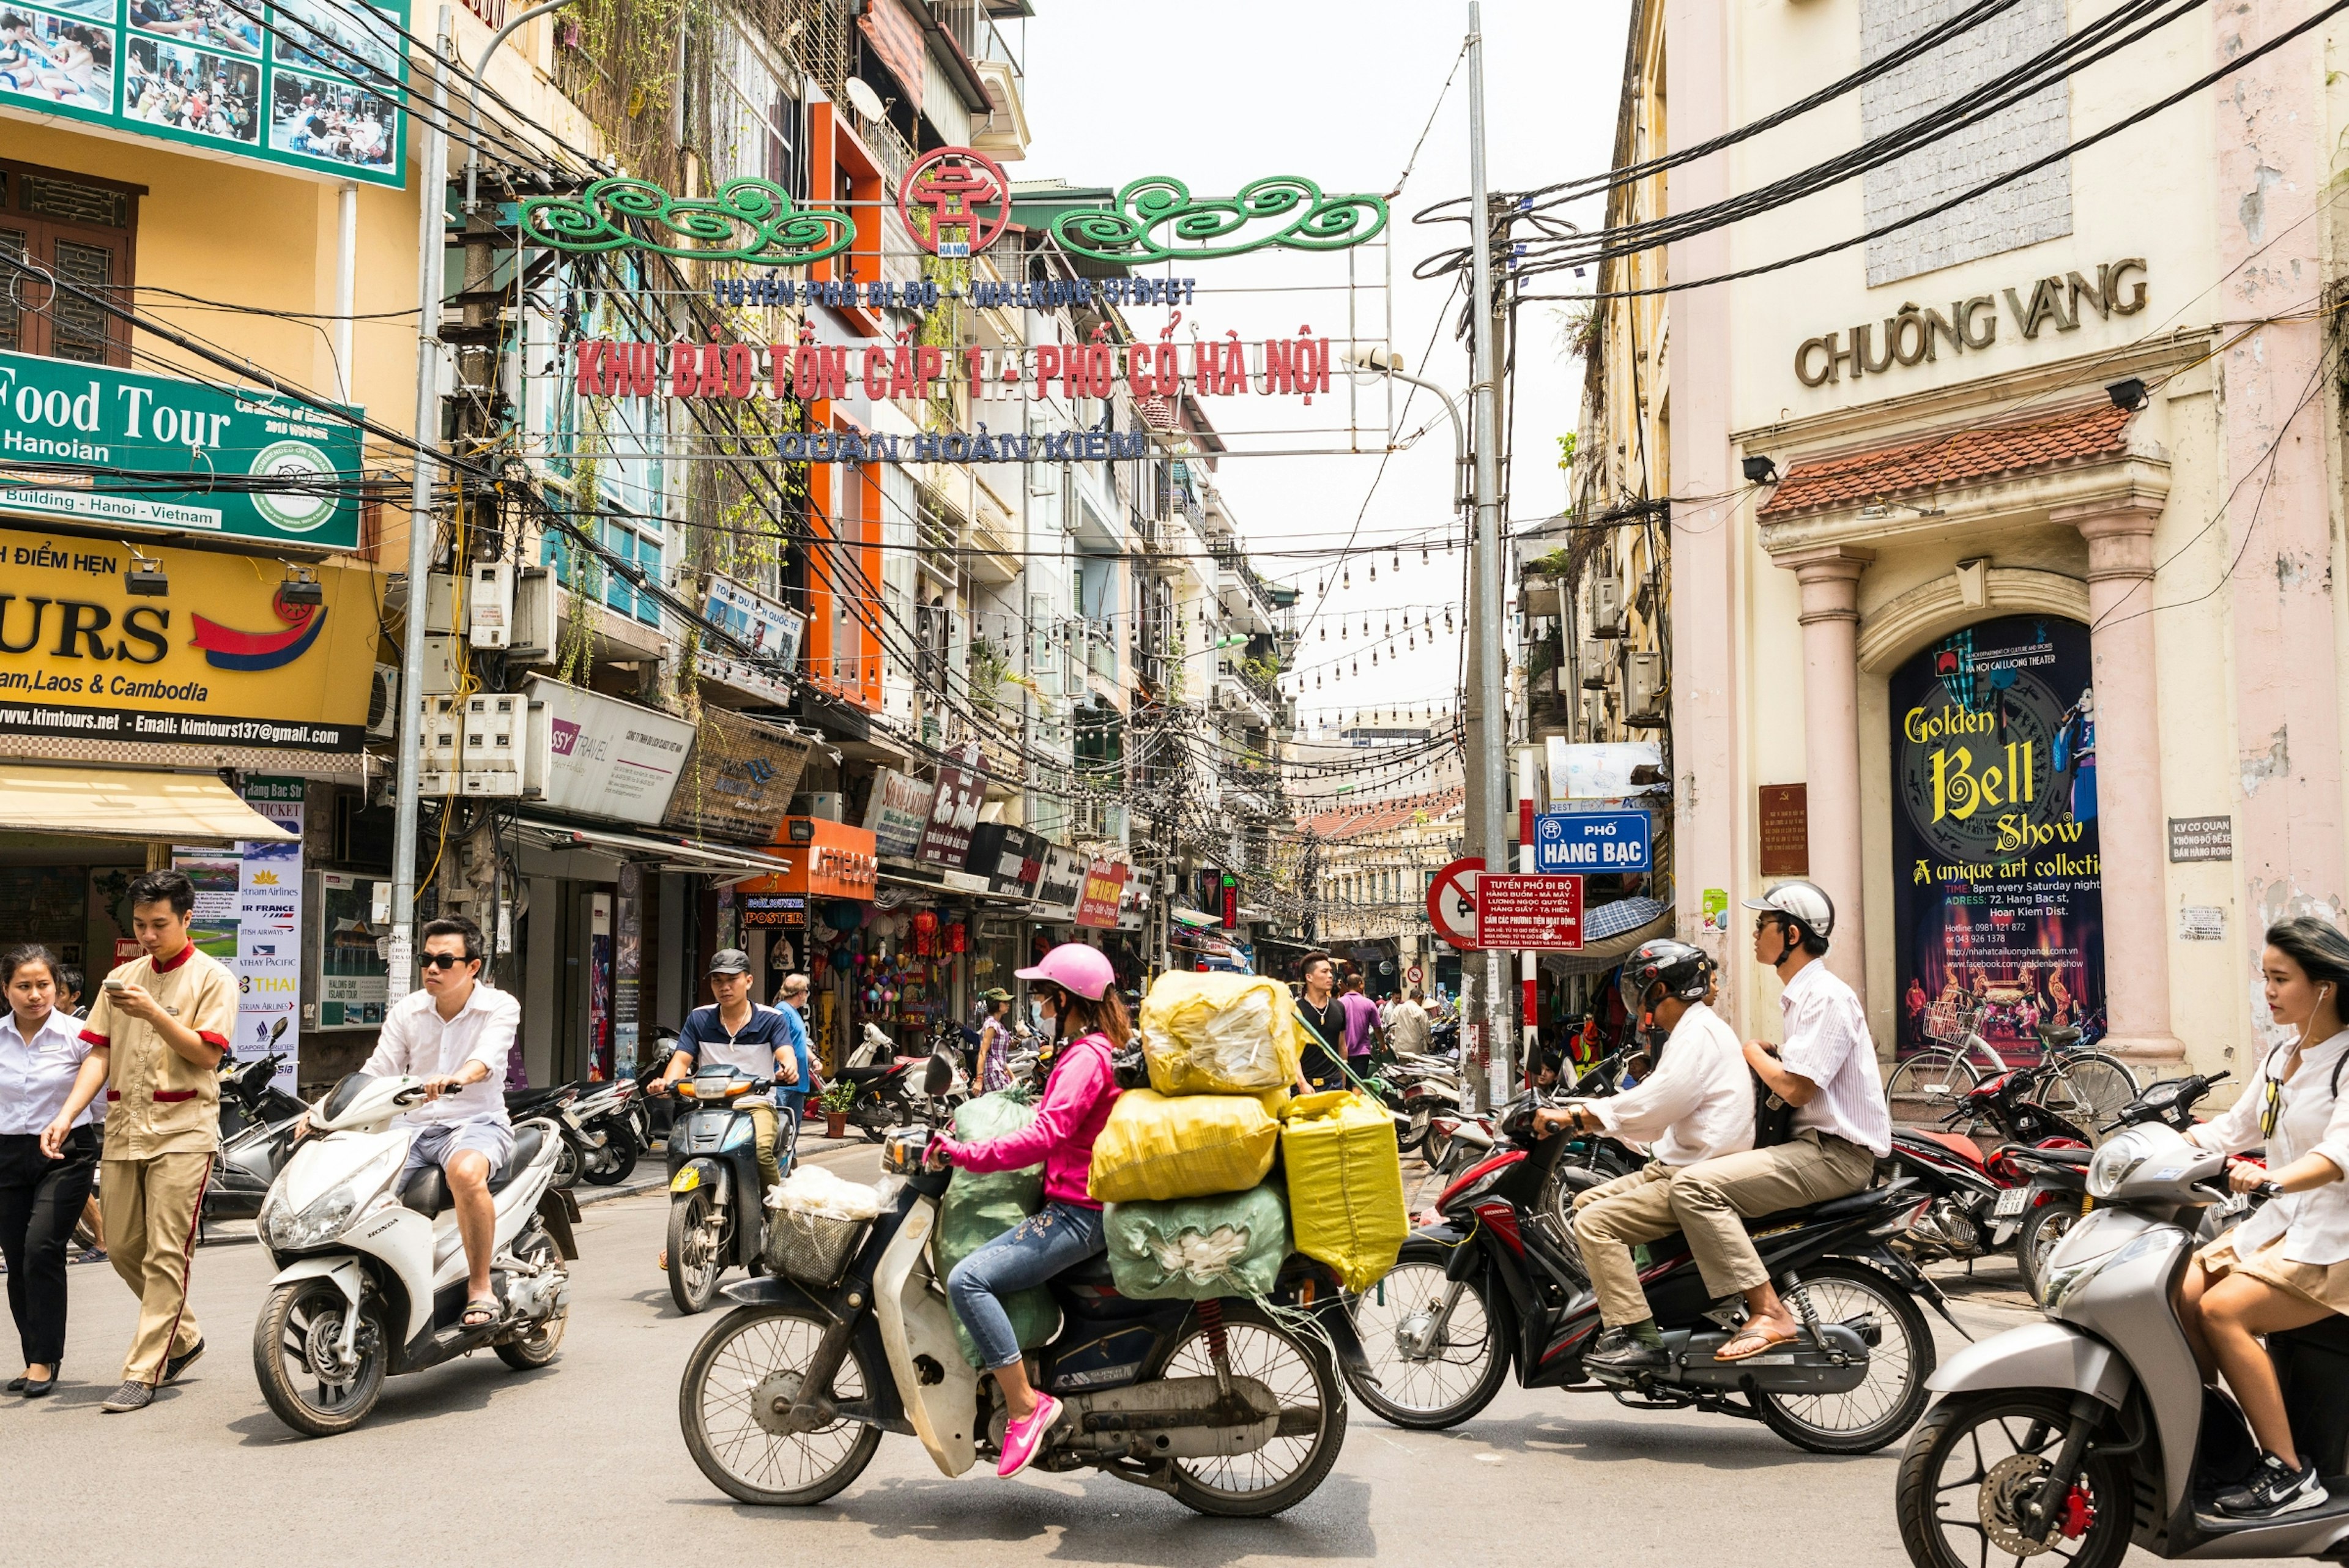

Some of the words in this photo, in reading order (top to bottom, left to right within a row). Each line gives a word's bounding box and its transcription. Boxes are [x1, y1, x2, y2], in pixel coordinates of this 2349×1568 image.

[940, 243, 951, 255] HÀ
[953, 244, 968, 258] NỘI
[713, 267, 795, 307] TUYẾN
[869, 280, 894, 308] ĐI
[973, 277, 1092, 307] WALKING
[1105, 277, 1195, 307] STREET
[1794, 300, 1997, 388] CHUÔNG
[2002, 257, 2148, 339] VÀNG
[577, 339, 656, 399] KHU
[673, 324, 752, 399] BẢO
[769, 320, 847, 400] TỒN
[863, 322, 942, 401] CẤP
[965, 350, 981, 399] 1
[1039, 321, 1113, 400] PHỐ
[1129, 310, 1180, 398] CỔ
[1195, 329, 1248, 396] HÀ
[1266, 324, 1330, 406] NỘI
[118, 385, 231, 448] Tour
[265, 420, 288, 434] 2015
[4, 429, 109, 463] Hanoian
[778, 425, 897, 472] QUẬN
[916, 422, 1030, 463] HOÀN
[1042, 415, 1145, 461] KIẾM
[6, 489, 75, 510] Building
[90, 497, 136, 515] Hanoi
[151, 506, 213, 524] Vietnam
[14, 540, 68, 570] ĐIỂM
[73, 554, 117, 576] HẸN
[738, 595, 749, 608] DU
[790, 620, 801, 632] TẾ
[1980, 648, 2003, 657] DEPARTMENT
[2010, 645, 2028, 655] CULTURE
[2036, 642, 2054, 651] SPORTS
[1965, 664, 1975, 674] HA
[1976, 662, 1990, 672] NOI
[1991, 661, 2002, 671] CAI
[2003, 657, 2028, 670] LUONG
[2028, 654, 2055, 667] THEATER
[89, 678, 105, 694] &
[109, 675, 209, 702] Cambodia
[1904, 704, 1995, 743] Golden
[135, 719, 178, 735] Email:
[180, 719, 340, 745] kimtours137@gmail.com
[573, 734, 609, 762] TRAVEL
[247, 782, 269, 798] Hang
[271, 782, 288, 798] Bac
[289, 784, 303, 798] Str
[1928, 741, 2035, 825] Bell
[258, 803, 301, 817] TICKET
[1550, 803, 1573, 811] REST
[1584, 821, 1618, 836] PHỐ
[1995, 811, 2083, 852] Show
[2188, 822, 2201, 832] CƠ
[2202, 821, 2230, 832] QUAN
[2173, 834, 2200, 845] KHÔNG
[2222, 834, 2232, 844] XE
[1545, 839, 1597, 863] HÀNG
[1603, 841, 1642, 866] BẠC
[2173, 846, 2189, 858] BÁN
[2189, 846, 2210, 857] HÀNG
[2210, 846, 2232, 856] RONG
[1913, 858, 1931, 885] A
[1936, 860, 1994, 885] unique
[2000, 856, 2028, 877] art
[268, 887, 299, 896] Airlines
[1490, 877, 1521, 890] TUYẾN
[1523, 878, 1543, 890] PHỐ
[1557, 880, 1572, 893] BỘ
[1945, 884, 1970, 894] TIME:
[1972, 883, 1995, 896] 8pm
[1997, 884, 2024, 895] every
[2026, 882, 2071, 893] Saturday
[2074, 879, 2101, 891] night
[1225, 887, 1234, 927] MASSAGE
[1945, 896, 1987, 905] ADRESS:
[1989, 894, 2005, 904] 72.
[2006, 894, 2033, 906] Hang
[2035, 894, 2054, 903] Bac
[2057, 894, 2069, 905] st,
[746, 912, 804, 924] POSTER
[1990, 907, 2015, 917] Hoan
[2017, 907, 2043, 917] Kiem
[2046, 905, 2069, 916] Dist.
[1484, 913, 1497, 924] CẤM
[1497, 915, 1509, 924] CÁC
[1532, 915, 1545, 927] TIỆN
[1560, 915, 1576, 927] ĐỘNG
[1945, 924, 1973, 932] Hotline:
[1975, 923, 1993, 932] 0981
[2011, 923, 2026, 931] 872
[1987, 934, 2006, 943] 1378
[116, 943, 144, 957] LAUNDRY
[1946, 946, 2079, 958] http://nhahatcailuonghanoi.com.vn
[265, 957, 296, 967] PACIFIC
[1946, 959, 2084, 968] www.facebook.com/goldenbellshow
[253, 978, 296, 992] THAI
[328, 979, 347, 989] HALONG
[347, 980, 357, 989] BAY
[328, 990, 344, 999] ISLAND
[346, 990, 358, 999] TOUR
[262, 1001, 288, 1010] AIRLINES
[1483, 1208, 1510, 1216] HONDA
[367, 1218, 399, 1239] HONDA
[1090, 1368, 1124, 1378] SUPER
